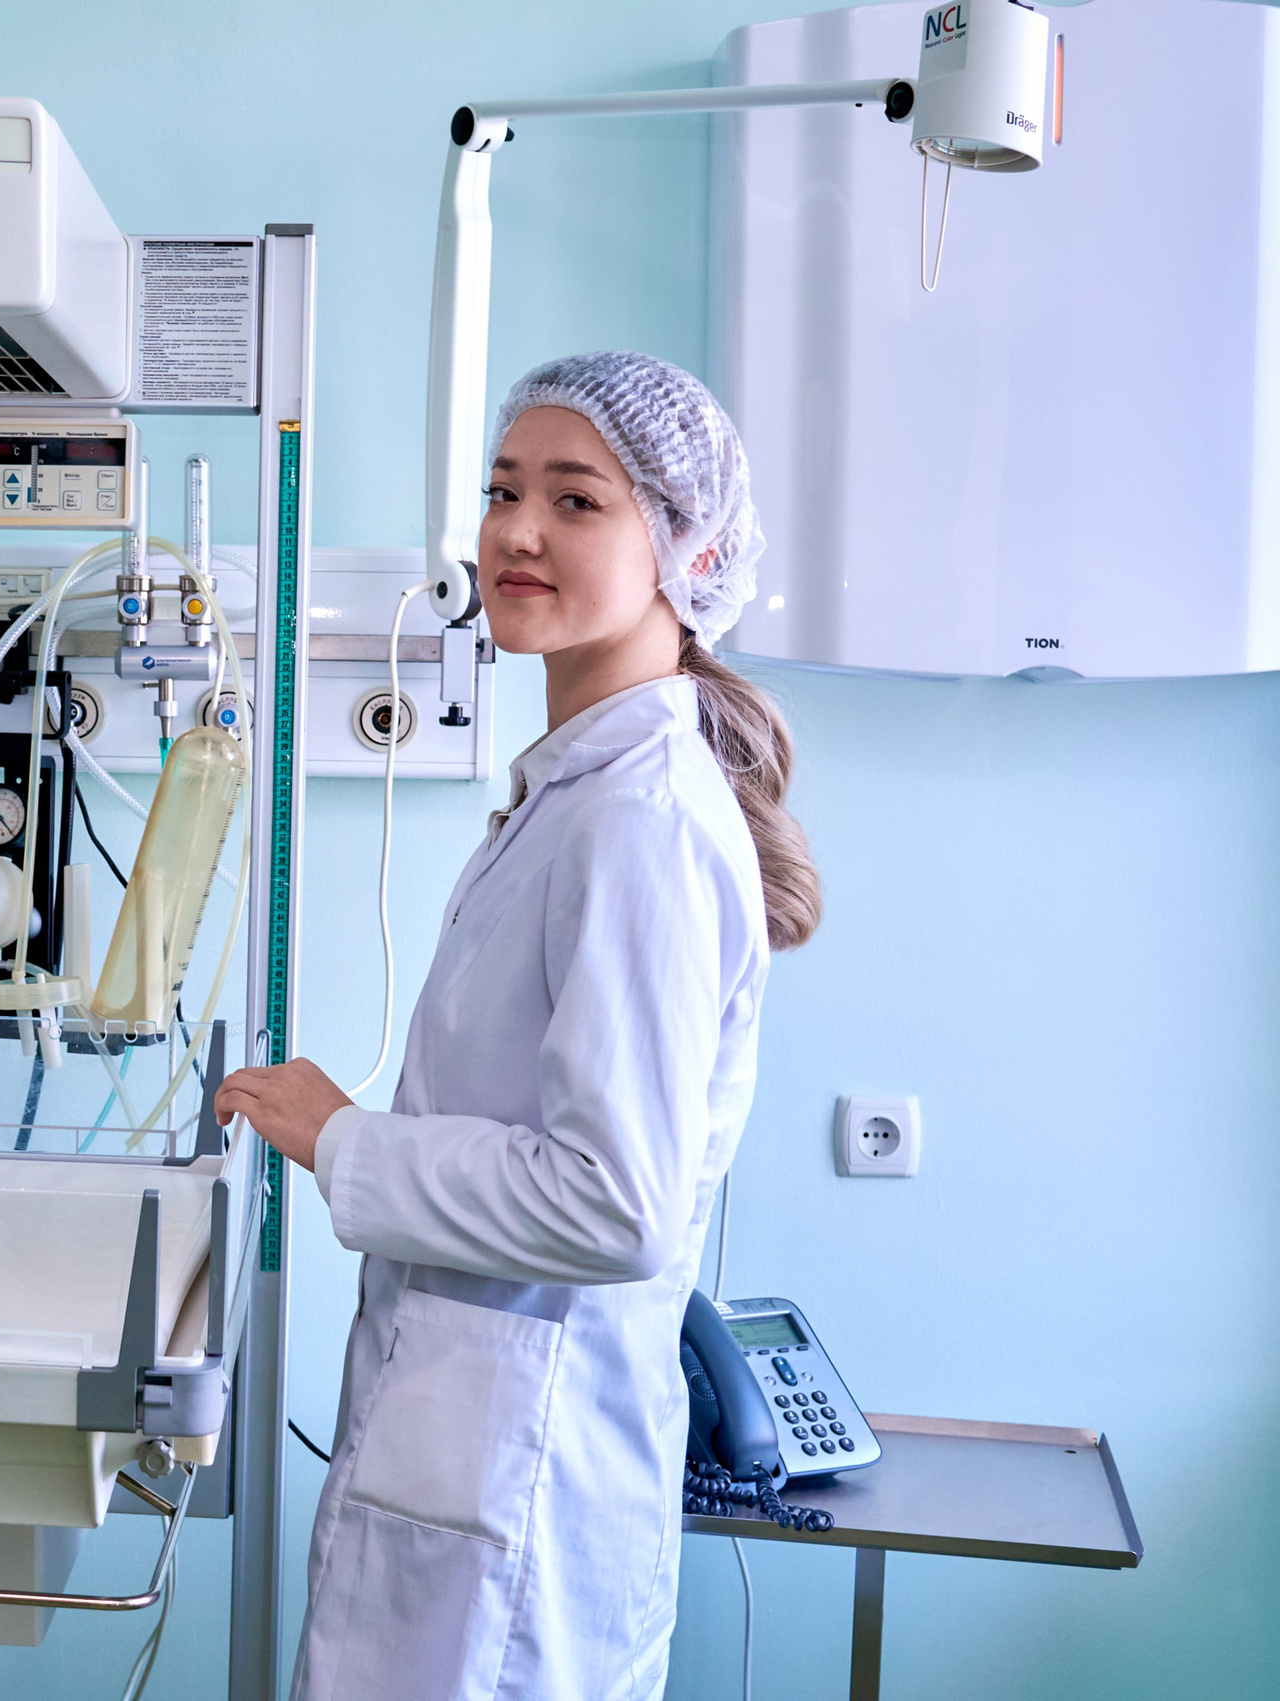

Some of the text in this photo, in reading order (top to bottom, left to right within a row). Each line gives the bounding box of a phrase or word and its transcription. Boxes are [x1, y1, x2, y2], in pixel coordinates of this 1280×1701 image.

[925, 5, 967, 41] NCL
[924, 38, 942, 50] Natural
[955, 30, 966, 39] Light
[1006, 110, 1037, 133] Dräger
[288, 446, 292, 455] 3
[288, 458, 293, 466] 4
[287, 504, 291, 512] 8
[286, 515, 291, 523] 9
[284, 560, 291, 569] 13
[284, 583, 291, 592] 15
[283, 606, 291, 614] 17
[283, 618, 290, 626] 18
[1025, 638, 1059, 649] TION
[282, 686, 289, 694] 24
[281, 708, 289, 717] 26
[281, 720, 288, 728] 27
[279, 788, 287, 796] 33
[279, 811, 286, 819] 35
[279, 833, 286, 842] 37
[278, 845, 285, 853] 38
[278, 856, 285, 865] 39
[274, 981, 282, 990] 50
[274, 992, 281, 1001] 51
[273, 1026, 280, 1035] 54
[272, 1049, 280, 1057] 56
